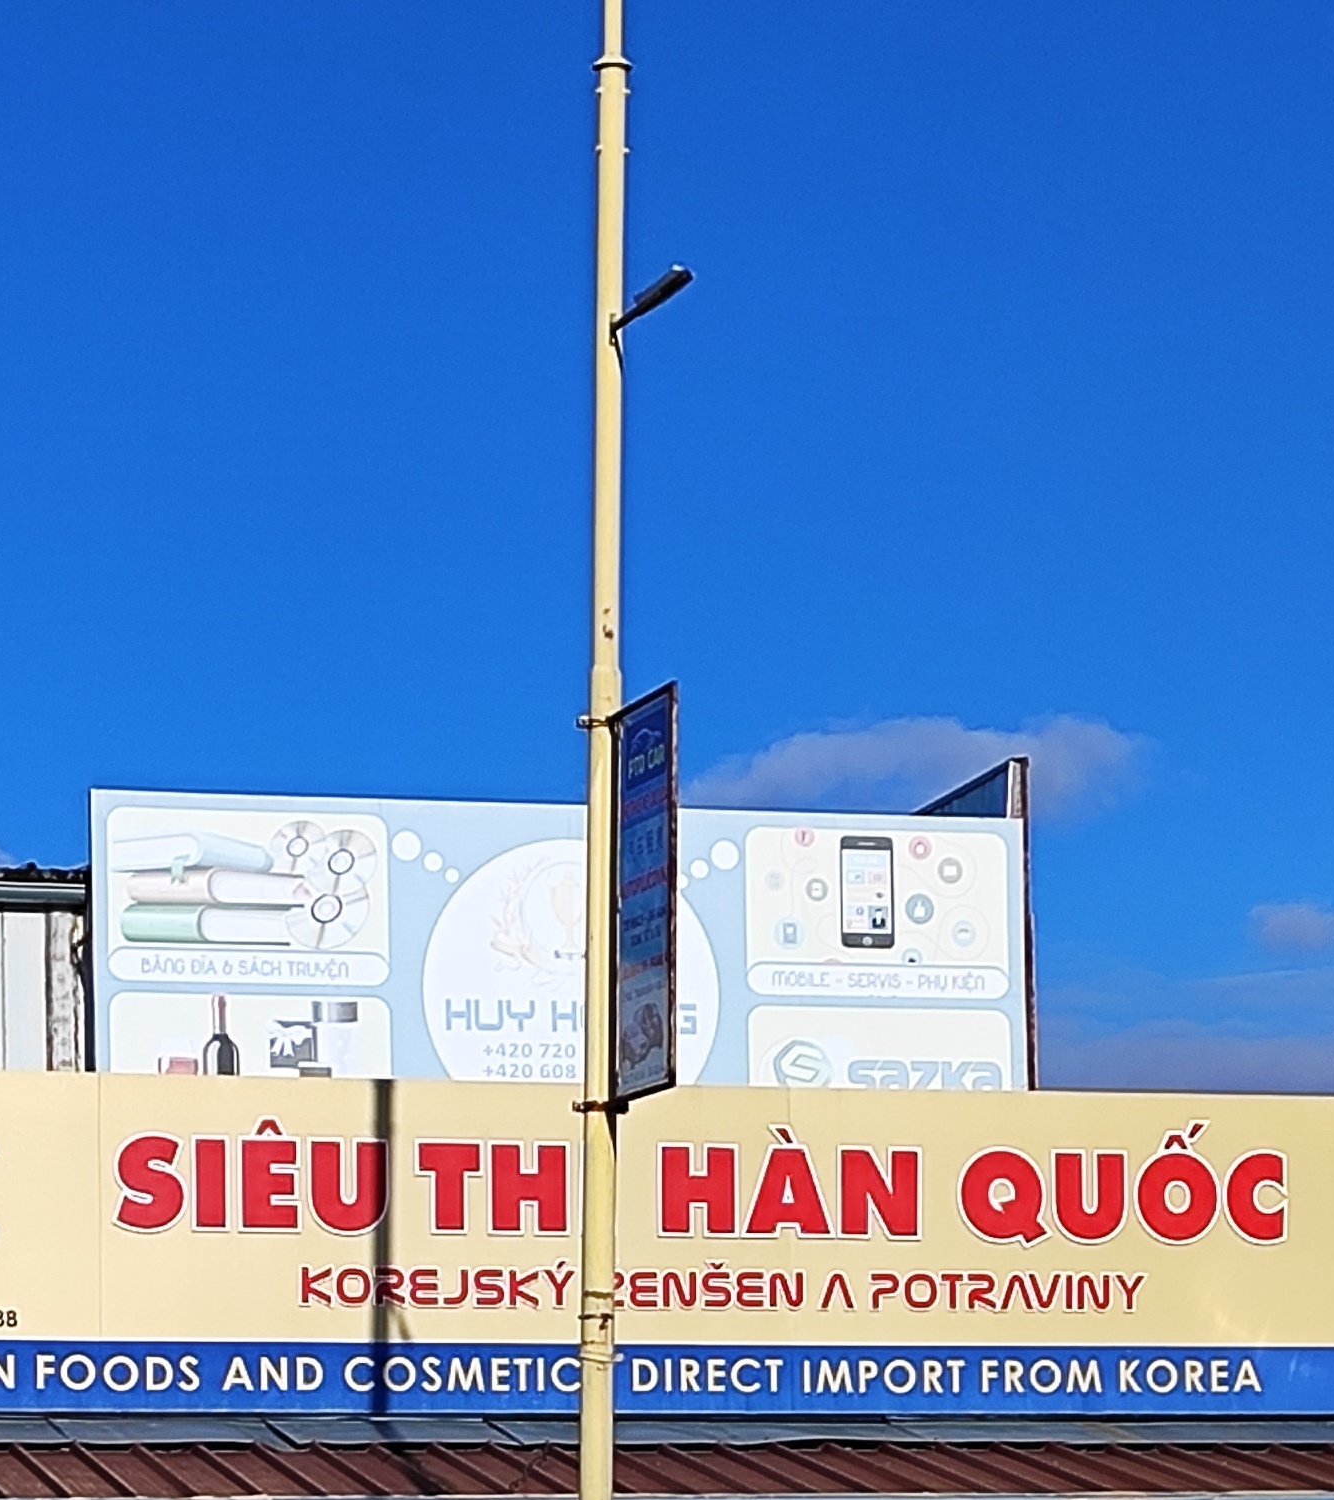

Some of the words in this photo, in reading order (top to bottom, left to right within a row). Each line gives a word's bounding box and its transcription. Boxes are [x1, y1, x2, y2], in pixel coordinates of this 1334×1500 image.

[239, 956, 283, 977] SÁCH
[772, 970, 831, 988] MOBILE
[848, 973, 901, 990] SERVIS
[445, 998, 535, 1032] HUY
[483, 1043, 532, 1058] +420
[540, 1043, 576, 1059] 720
[483, 1064, 533, 1078] +420
[540, 1064, 576, 1078] 608
[114, 1118, 388, 1235] SIÊU
[414, 1138, 571, 1235] TH
[658, 1124, 922, 1239] HÀN
[957, 1119, 1288, 1247] QUỐC
[299, 1261, 576, 1309] KOREJSKÝ
[869, 1270, 1148, 1313] POTRAVINY
[35, 1354, 201, 1392] FOODS
[222, 1356, 324, 1392] AND
[344, 1356, 582, 1393] COSMETIC
[631, 1358, 784, 1394] DIRECT
[803, 1359, 966, 1394] IMPORT
[981, 1359, 1103, 1394] FROM
[1119, 1359, 1262, 1394] KOREA
